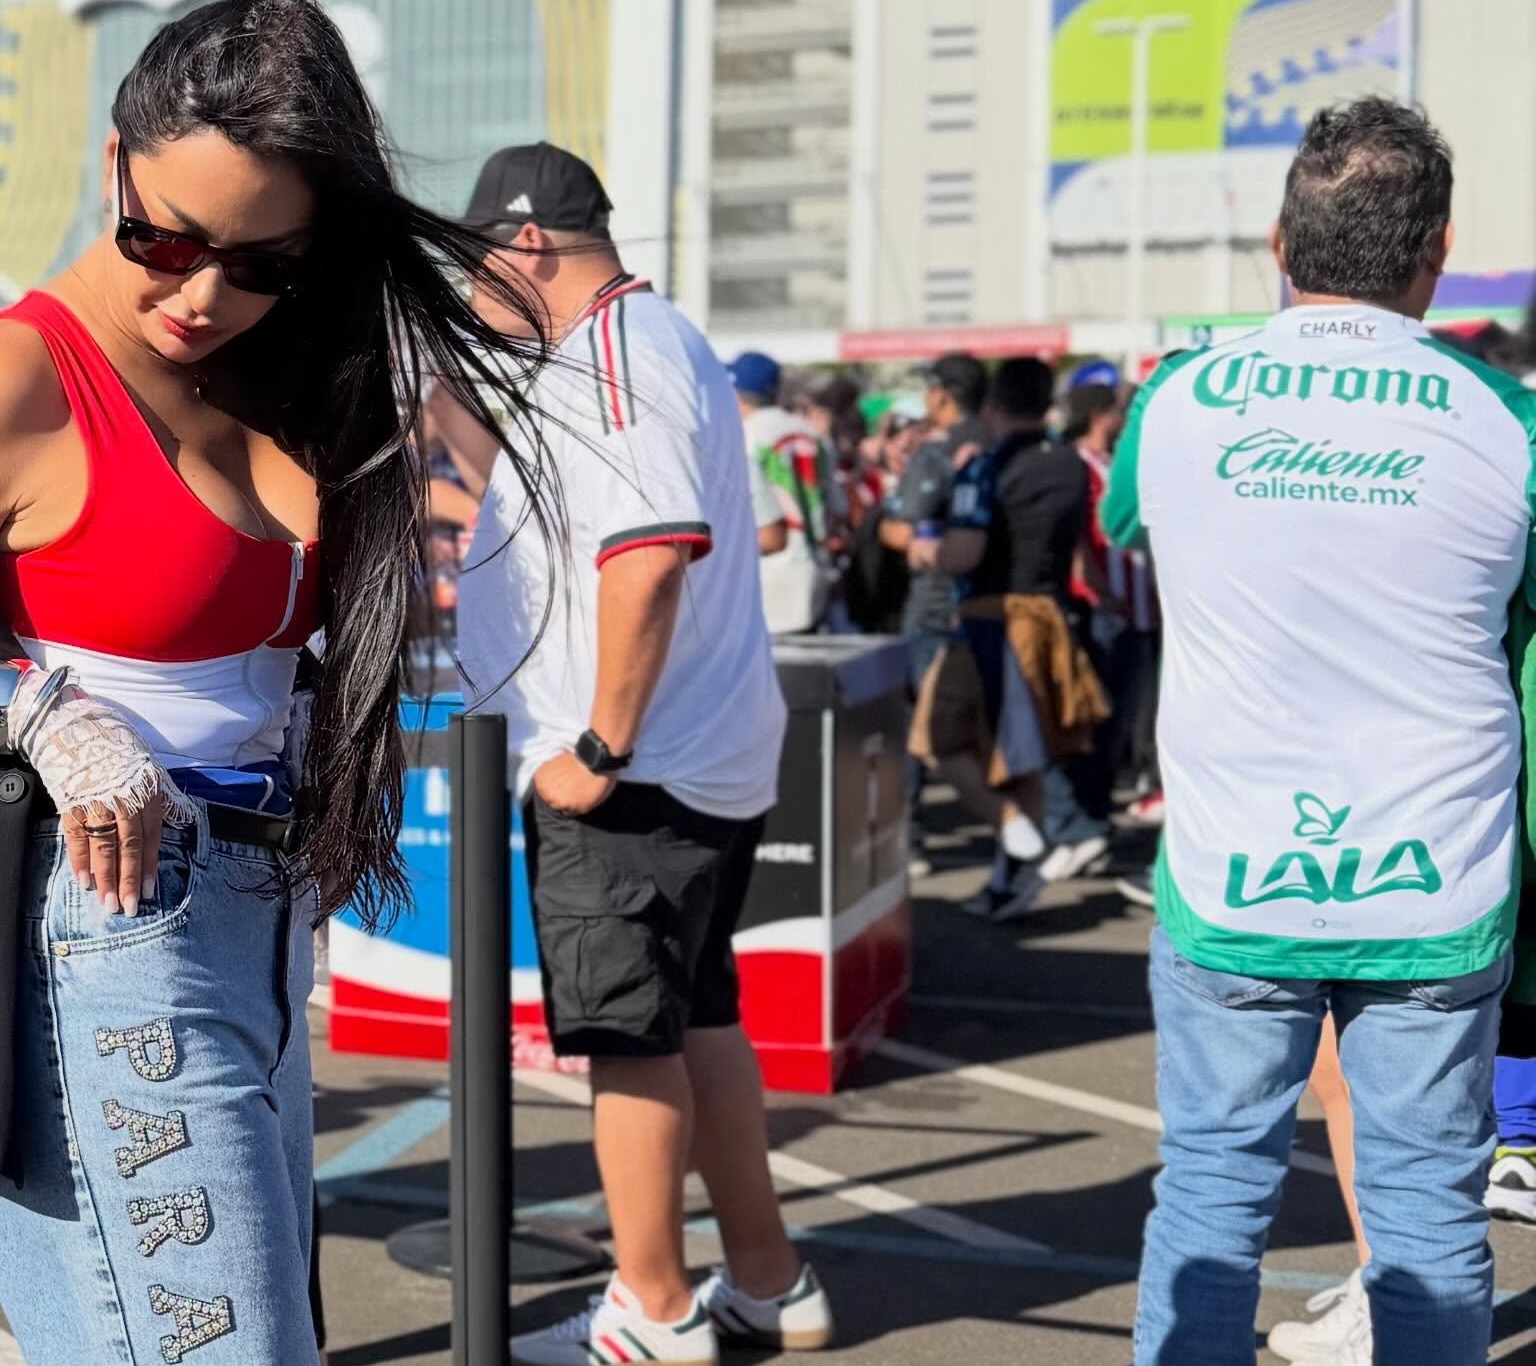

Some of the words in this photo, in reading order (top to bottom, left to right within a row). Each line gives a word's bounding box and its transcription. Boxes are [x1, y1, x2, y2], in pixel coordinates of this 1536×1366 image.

[1299, 322, 1376, 338] CHARLY
[1193, 350, 1453, 416] Corona
[1216, 427, 1425, 480] Caliente
[1234, 478, 1418, 506] caliente.mx
[1224, 839, 1442, 909] LALA
